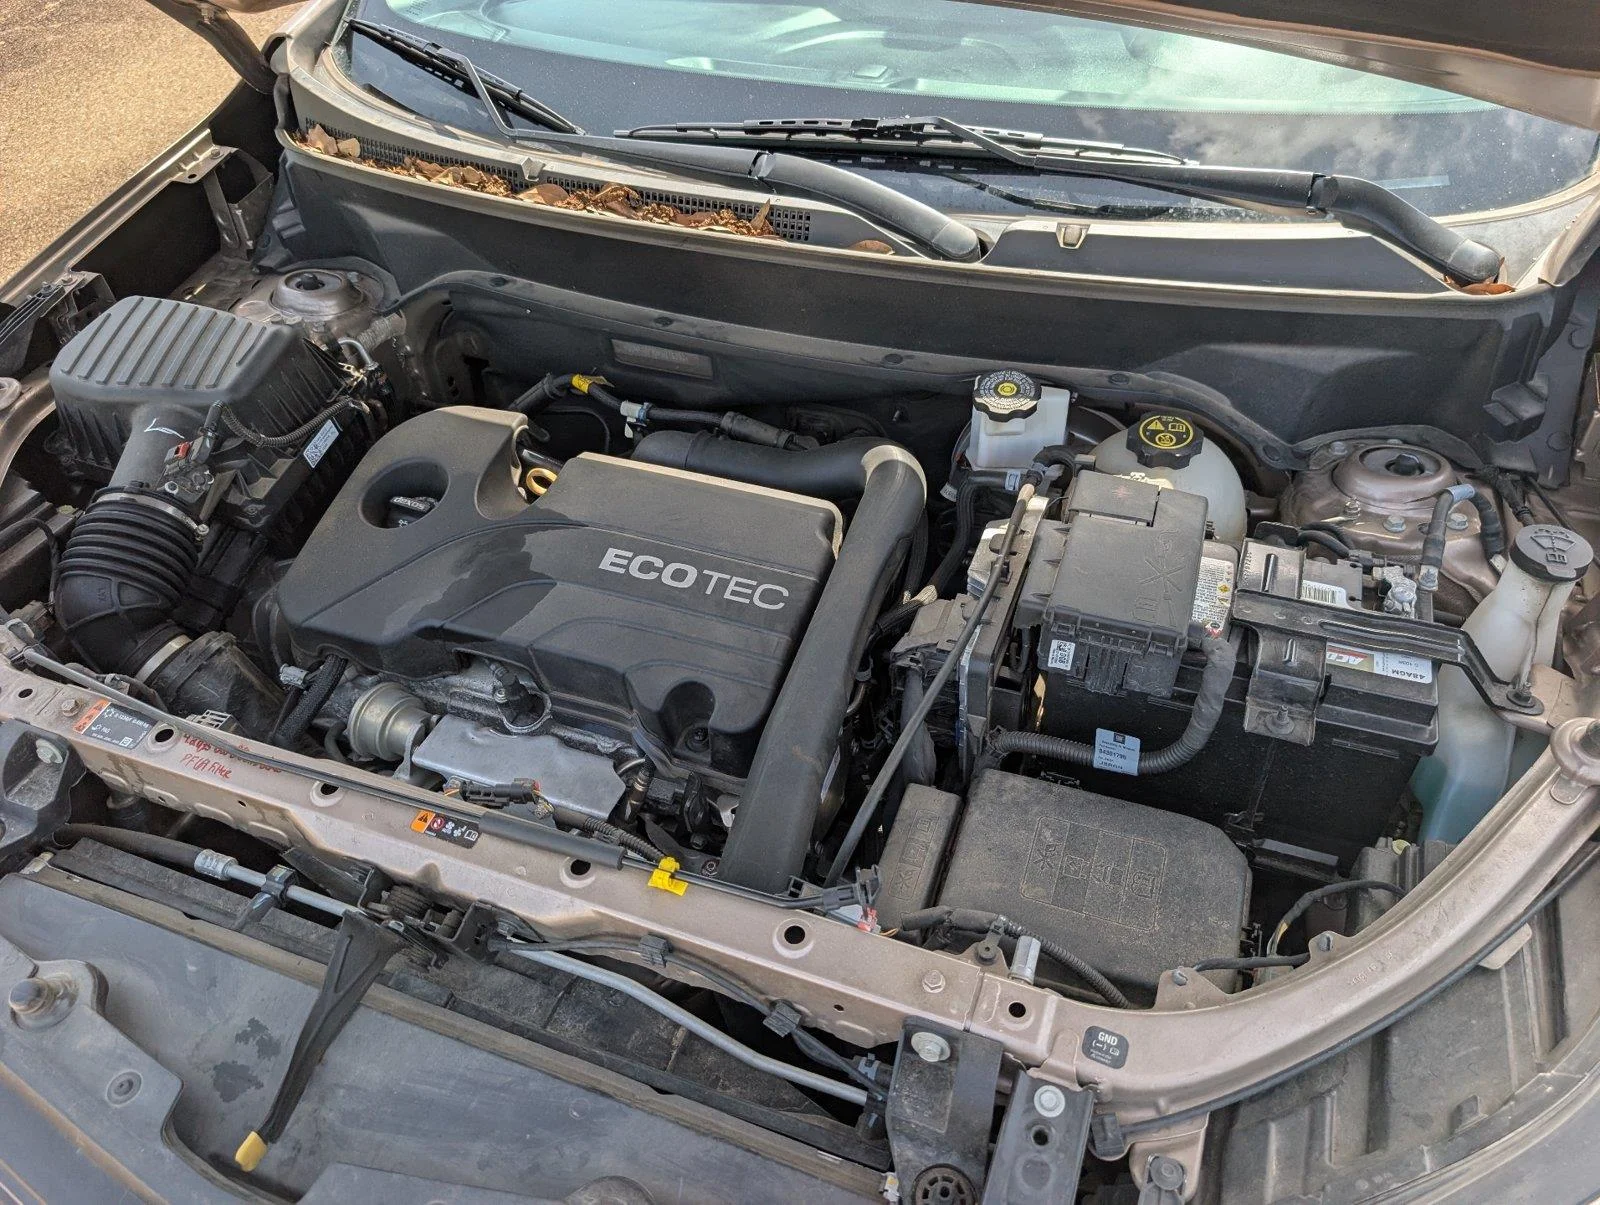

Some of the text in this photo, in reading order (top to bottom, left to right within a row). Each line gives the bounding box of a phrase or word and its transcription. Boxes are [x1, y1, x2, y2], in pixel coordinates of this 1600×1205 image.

[392, 496, 425, 510] dexos
[598, 547, 790, 611] ECOTEC
[1098, 1031, 1118, 1046] GND
